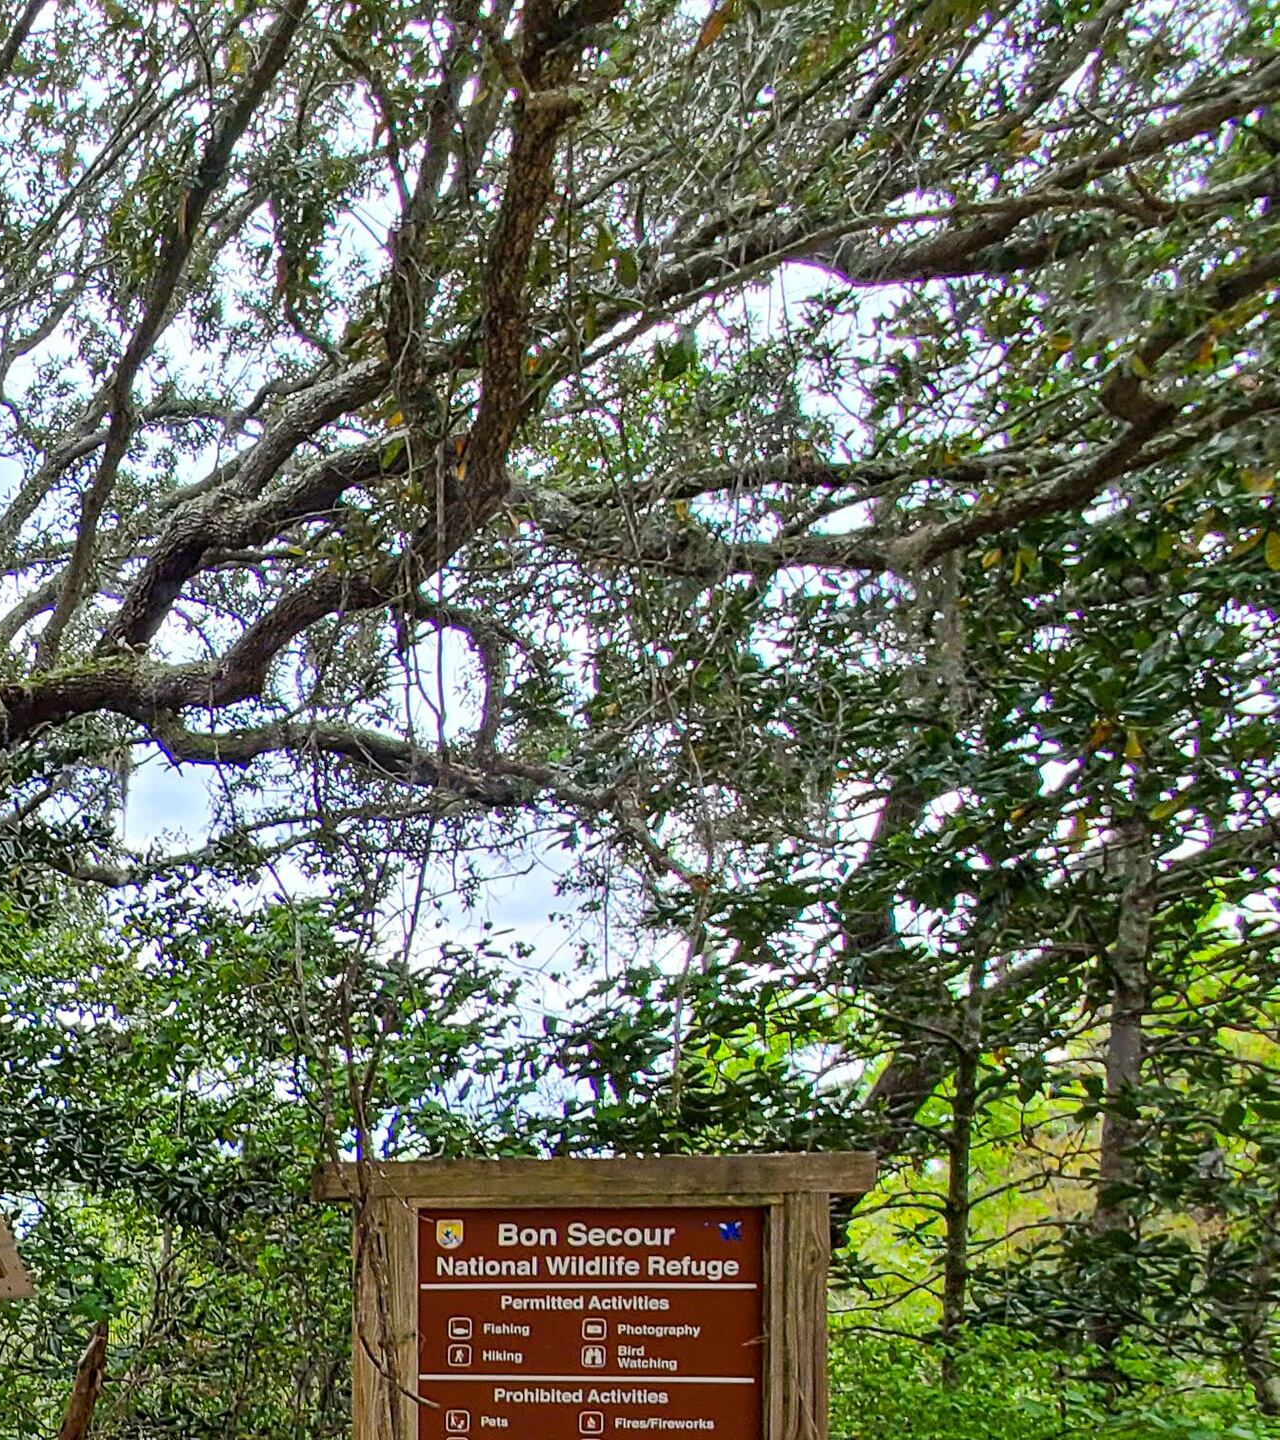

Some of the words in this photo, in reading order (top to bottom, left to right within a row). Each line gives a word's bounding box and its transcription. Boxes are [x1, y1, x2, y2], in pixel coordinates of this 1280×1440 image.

[498, 1224, 556, 1246] Bon
[568, 1223, 675, 1246] Secour
[437, 1256, 537, 1276] National
[546, 1256, 640, 1275] Wildlife
[648, 1256, 739, 1280] Refuge
[501, 1295, 583, 1310] Permitted
[589, 1296, 669, 1310] Activities
[484, 1323, 529, 1336] Fishing
[618, 1324, 700, 1337] Photography
[483, 1350, 522, 1363] Hiking
[618, 1346, 644, 1357] Bird
[618, 1358, 677, 1370] Watching
[495, 1388, 582, 1403] Prohibited
[588, 1389, 668, 1403] Activities
[481, 1416, 508, 1427] Pets
[615, 1418, 714, 1429] Fires/Fireworks
